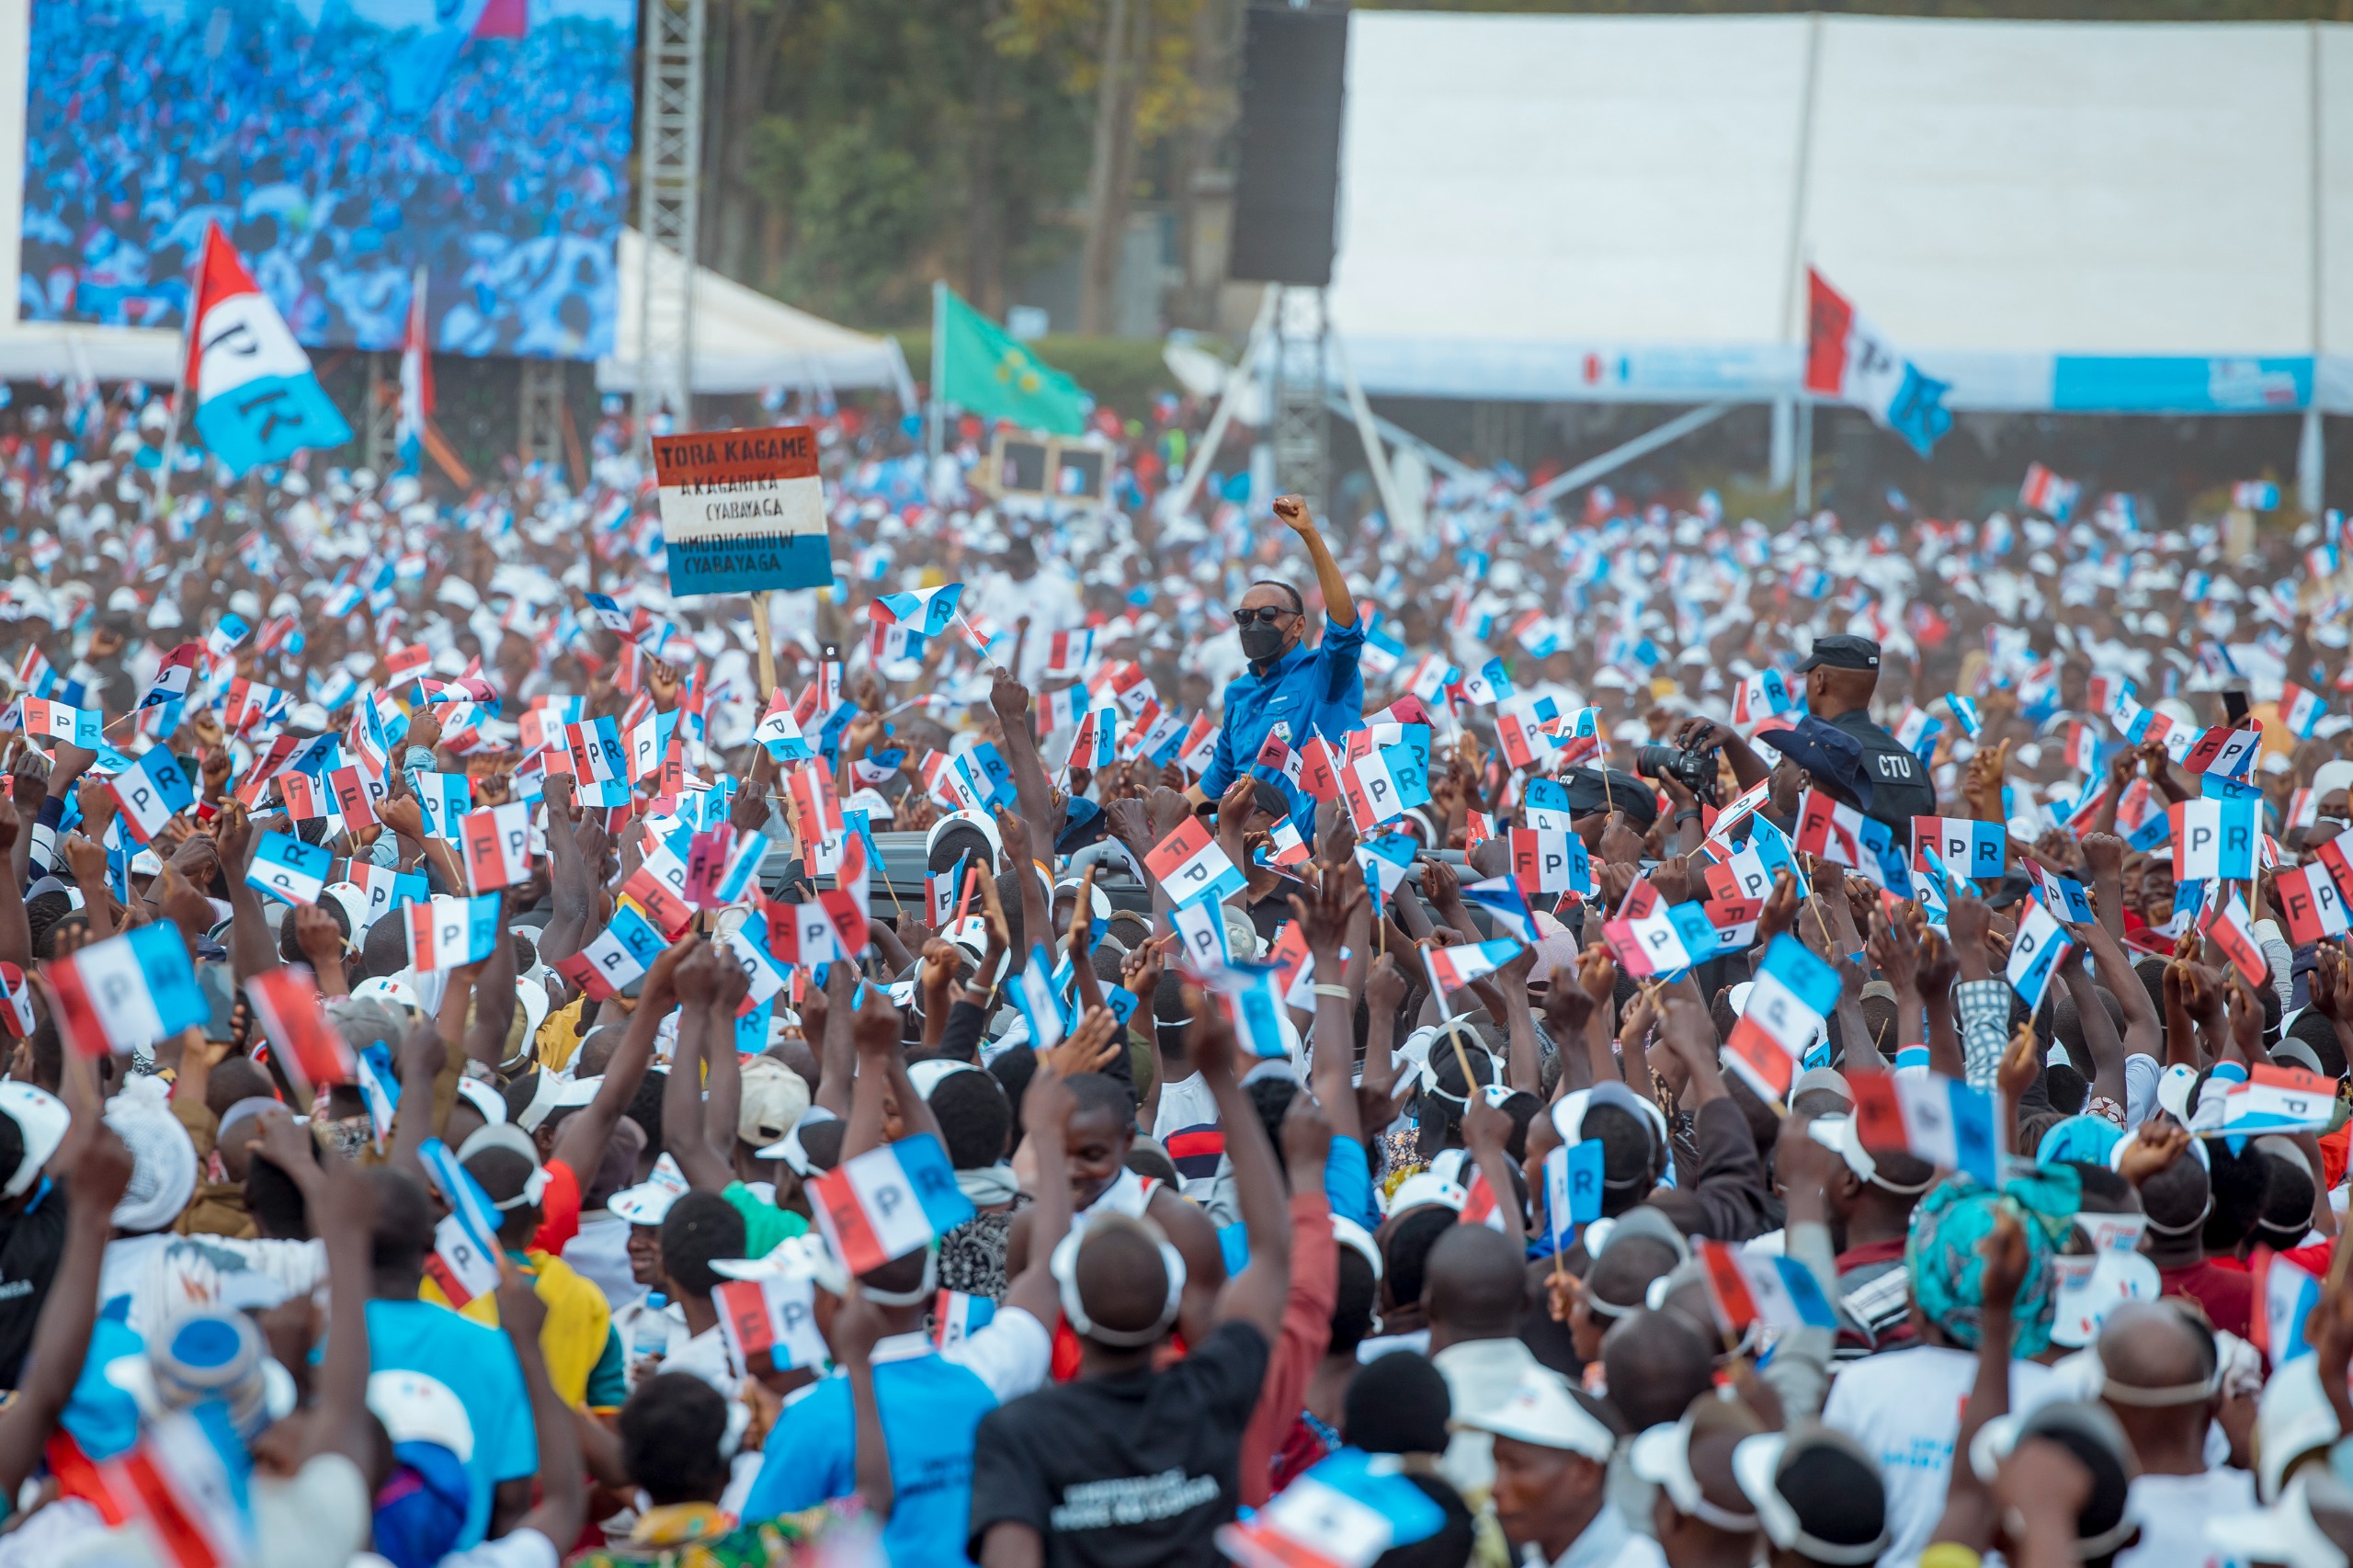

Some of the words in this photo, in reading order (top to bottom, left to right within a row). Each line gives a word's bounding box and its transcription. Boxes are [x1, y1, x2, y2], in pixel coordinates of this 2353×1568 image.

[724, 436, 808, 462] KAGAME
[706, 497, 784, 521] CYABAYAGA
[684, 553, 782, 574] CYABAYAGA
[1879, 754, 1912, 778] CTU
[1348, 767, 1417, 814] FPR
[1518, 852, 1588, 875] FPR
